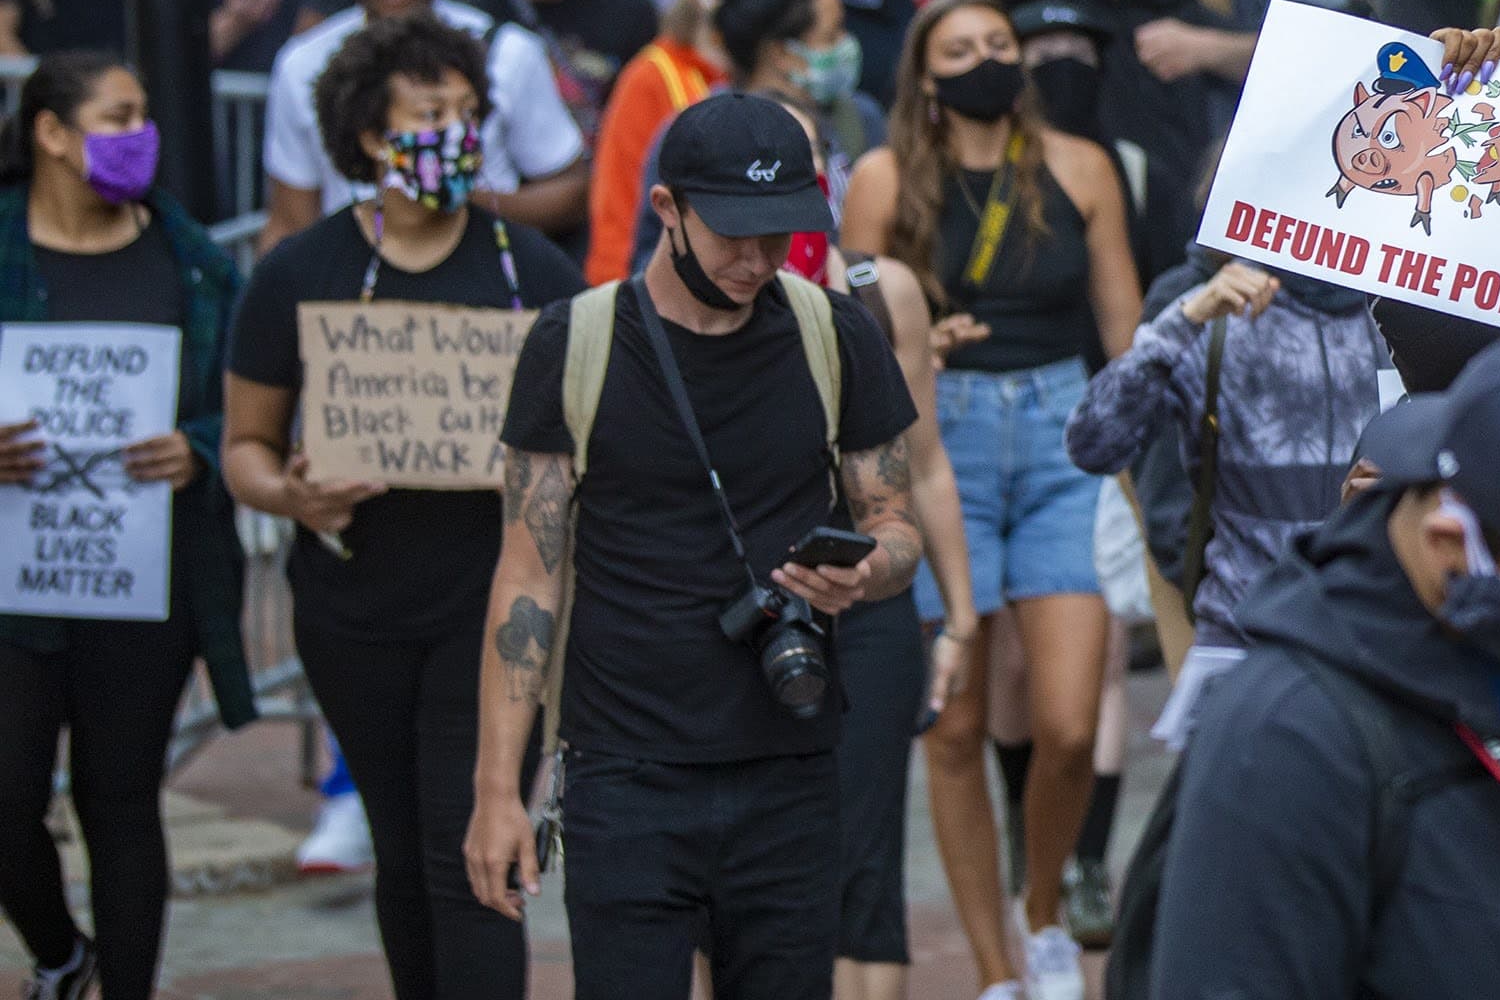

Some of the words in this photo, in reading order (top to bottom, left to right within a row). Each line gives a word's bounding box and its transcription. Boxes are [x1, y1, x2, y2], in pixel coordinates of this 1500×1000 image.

[1225, 200, 1371, 276] DEFUND
[1376, 243, 1448, 297] THE
[319, 312, 416, 352] What
[23, 344, 149, 376] DEFUND
[54, 377, 111, 404] THE
[328, 360, 449, 398] America
[30, 407, 134, 438] POLICE
[322, 402, 413, 439] Black
[29, 503, 129, 532] BLACK
[34, 536, 118, 564] LIVES
[16, 566, 136, 598] MATTER
